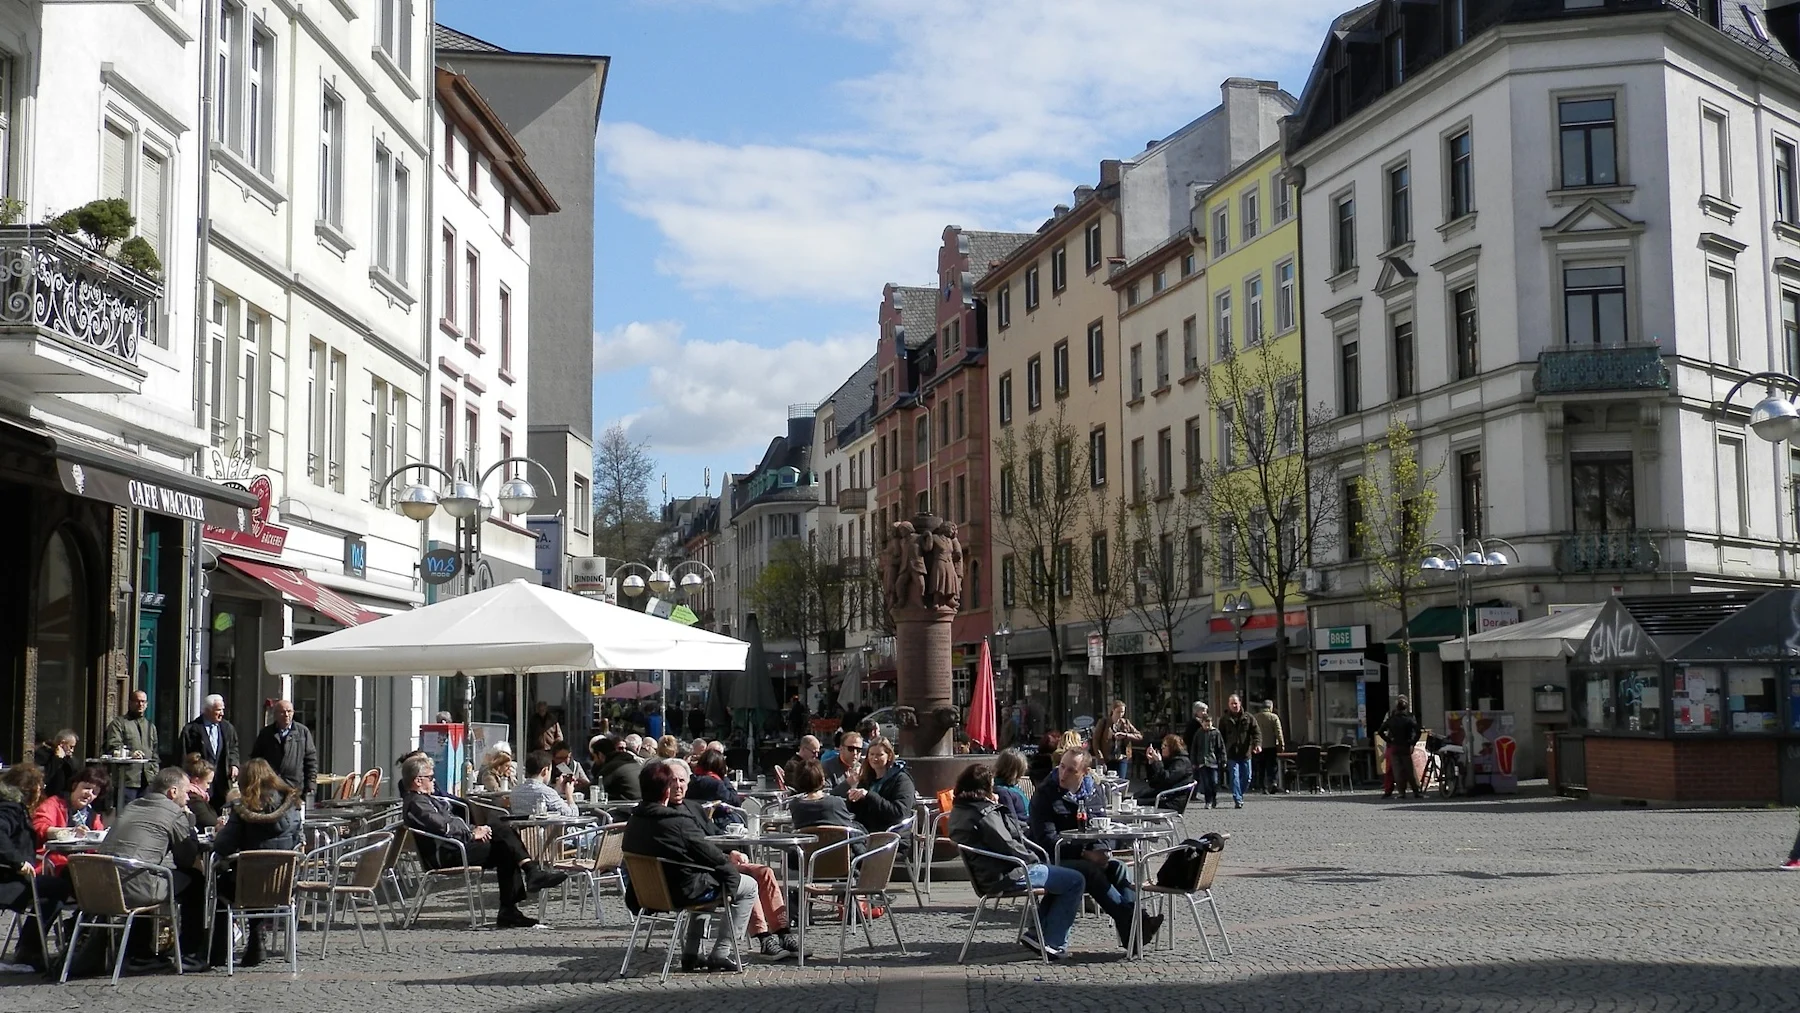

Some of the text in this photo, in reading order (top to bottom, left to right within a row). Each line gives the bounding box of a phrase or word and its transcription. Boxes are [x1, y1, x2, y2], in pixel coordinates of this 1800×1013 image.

[128, 479, 205, 521] CAFE WACKER
[261, 530, 283, 547] BÄCKEREI
[574, 574, 604, 583] BINDING
[1330, 632, 1350, 644] BASE
